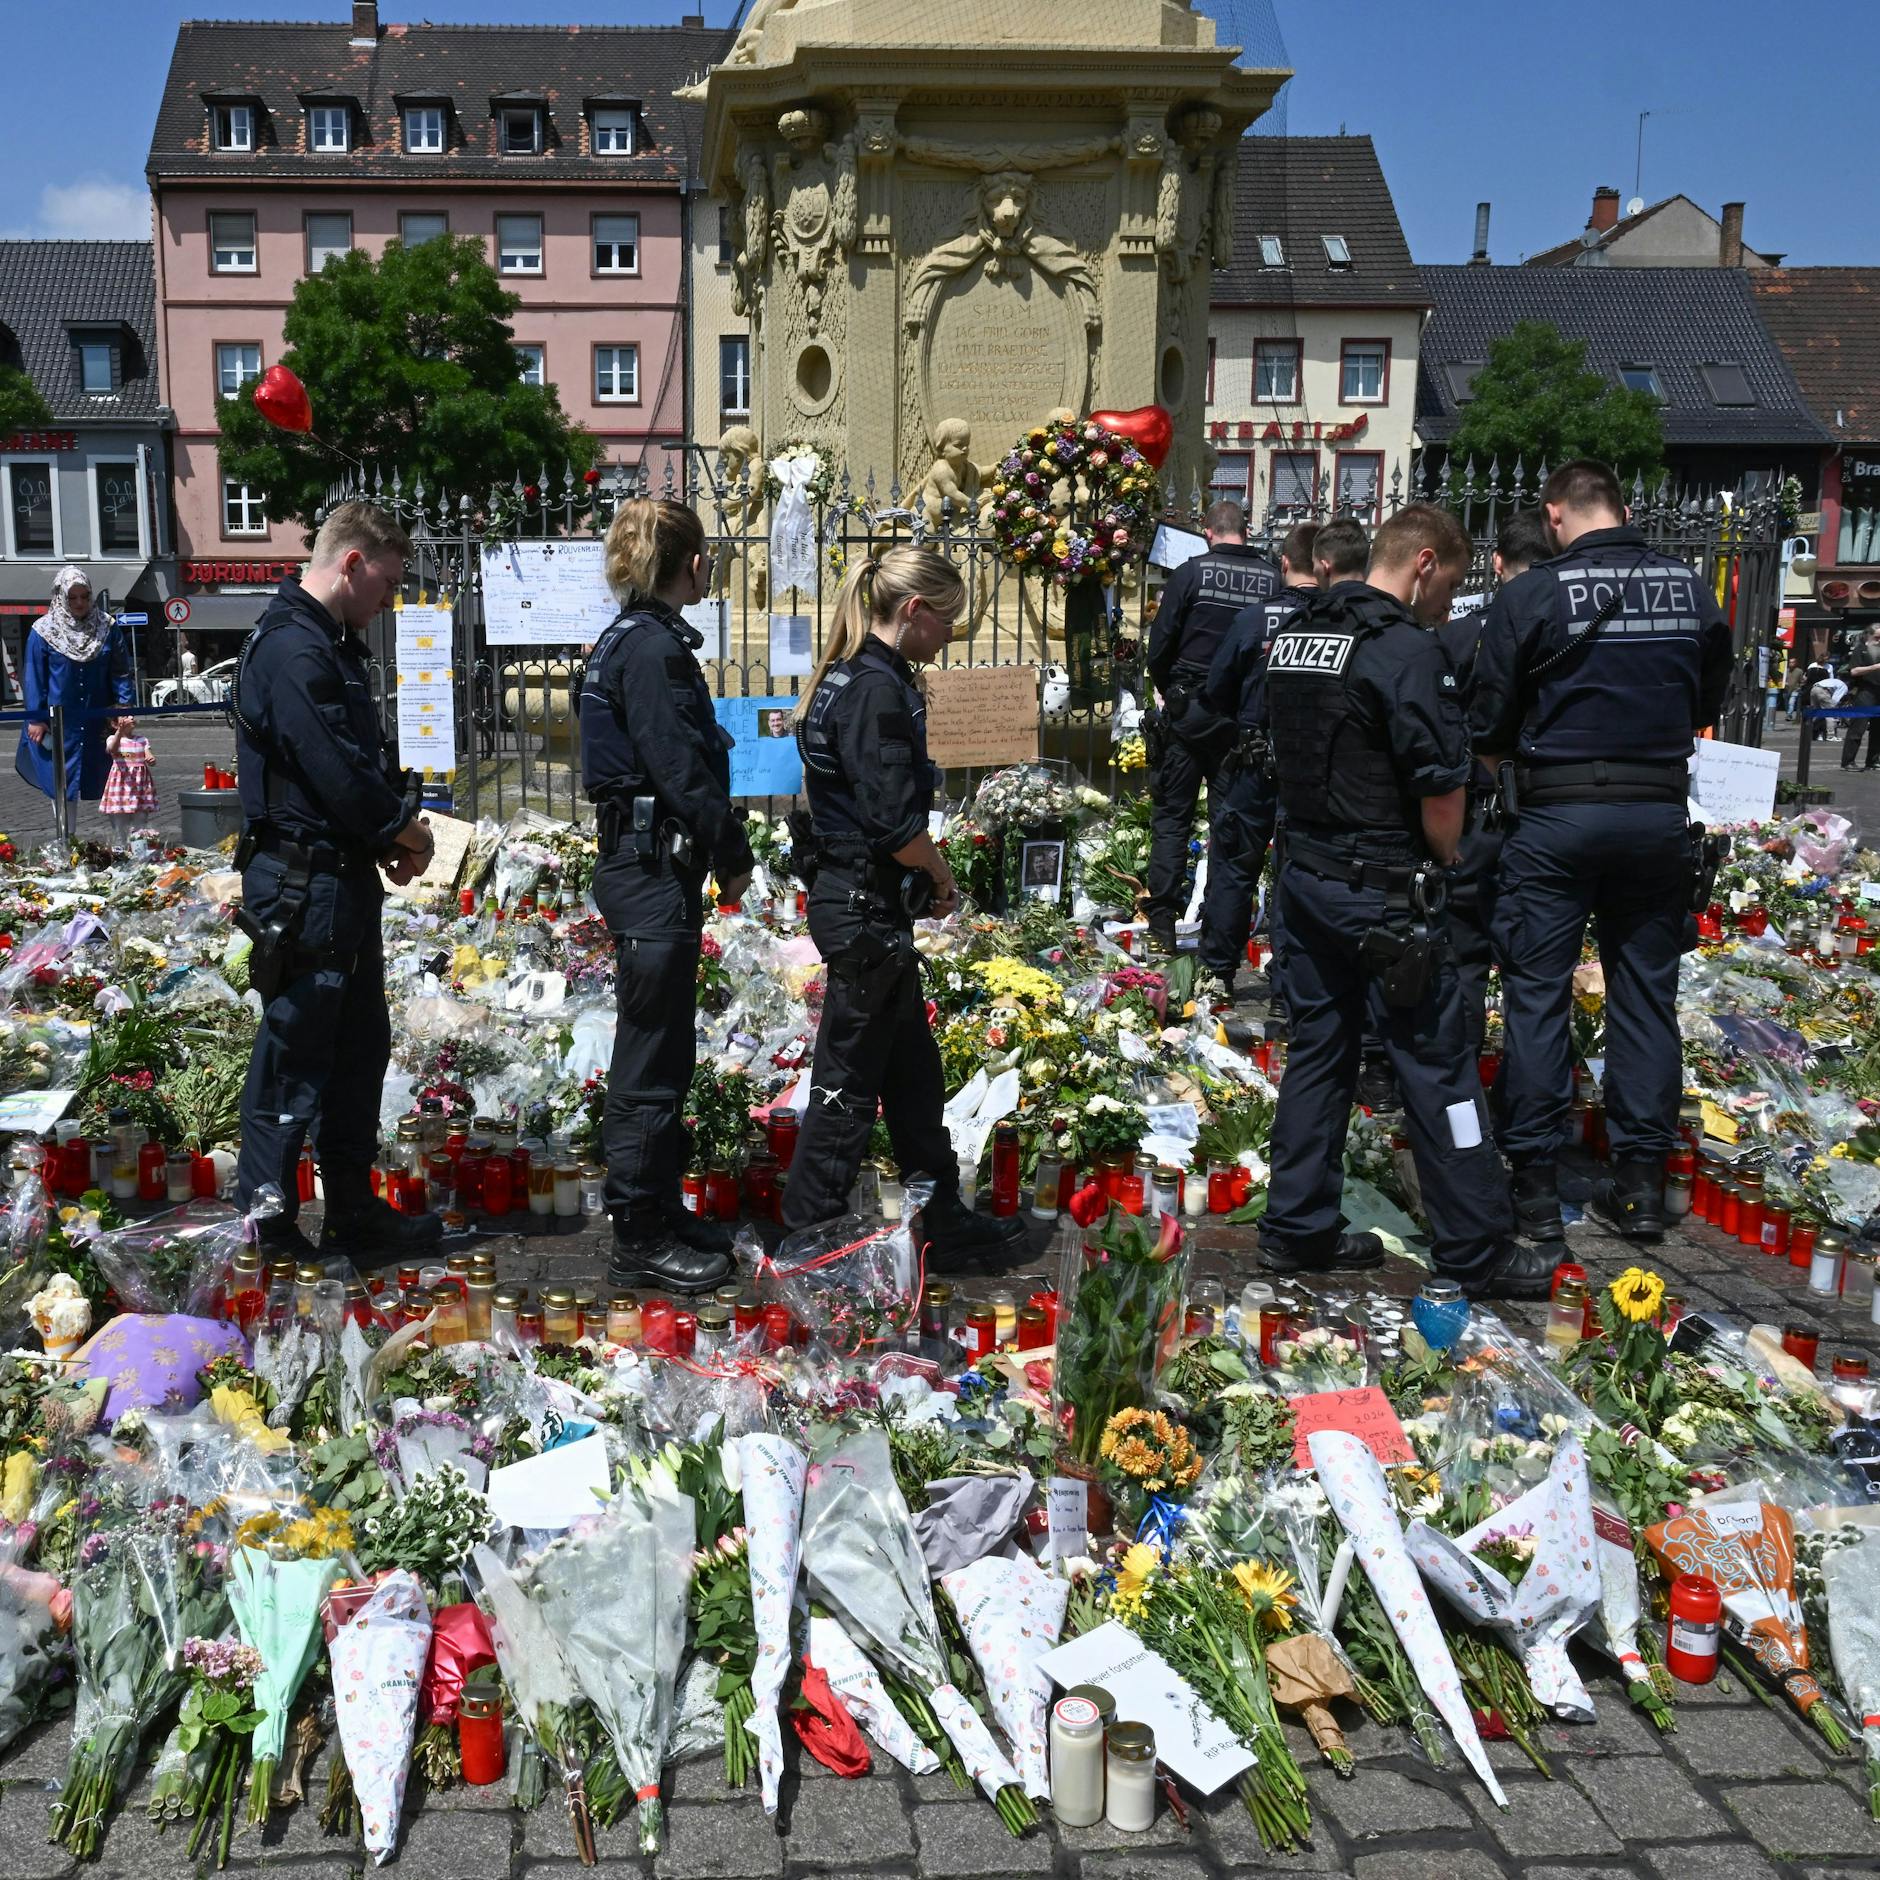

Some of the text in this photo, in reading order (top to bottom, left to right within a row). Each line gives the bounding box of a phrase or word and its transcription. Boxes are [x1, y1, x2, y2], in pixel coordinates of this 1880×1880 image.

[1201, 569, 1273, 596] POLIZEI
[1567, 582, 1696, 616] POLIZEI
[1266, 616, 1279, 637] P
[1269, 638, 1348, 669] POLIZEI
[1083, 1650, 1150, 1685] Never forgotten
[1203, 1744, 1219, 1760] RIP
